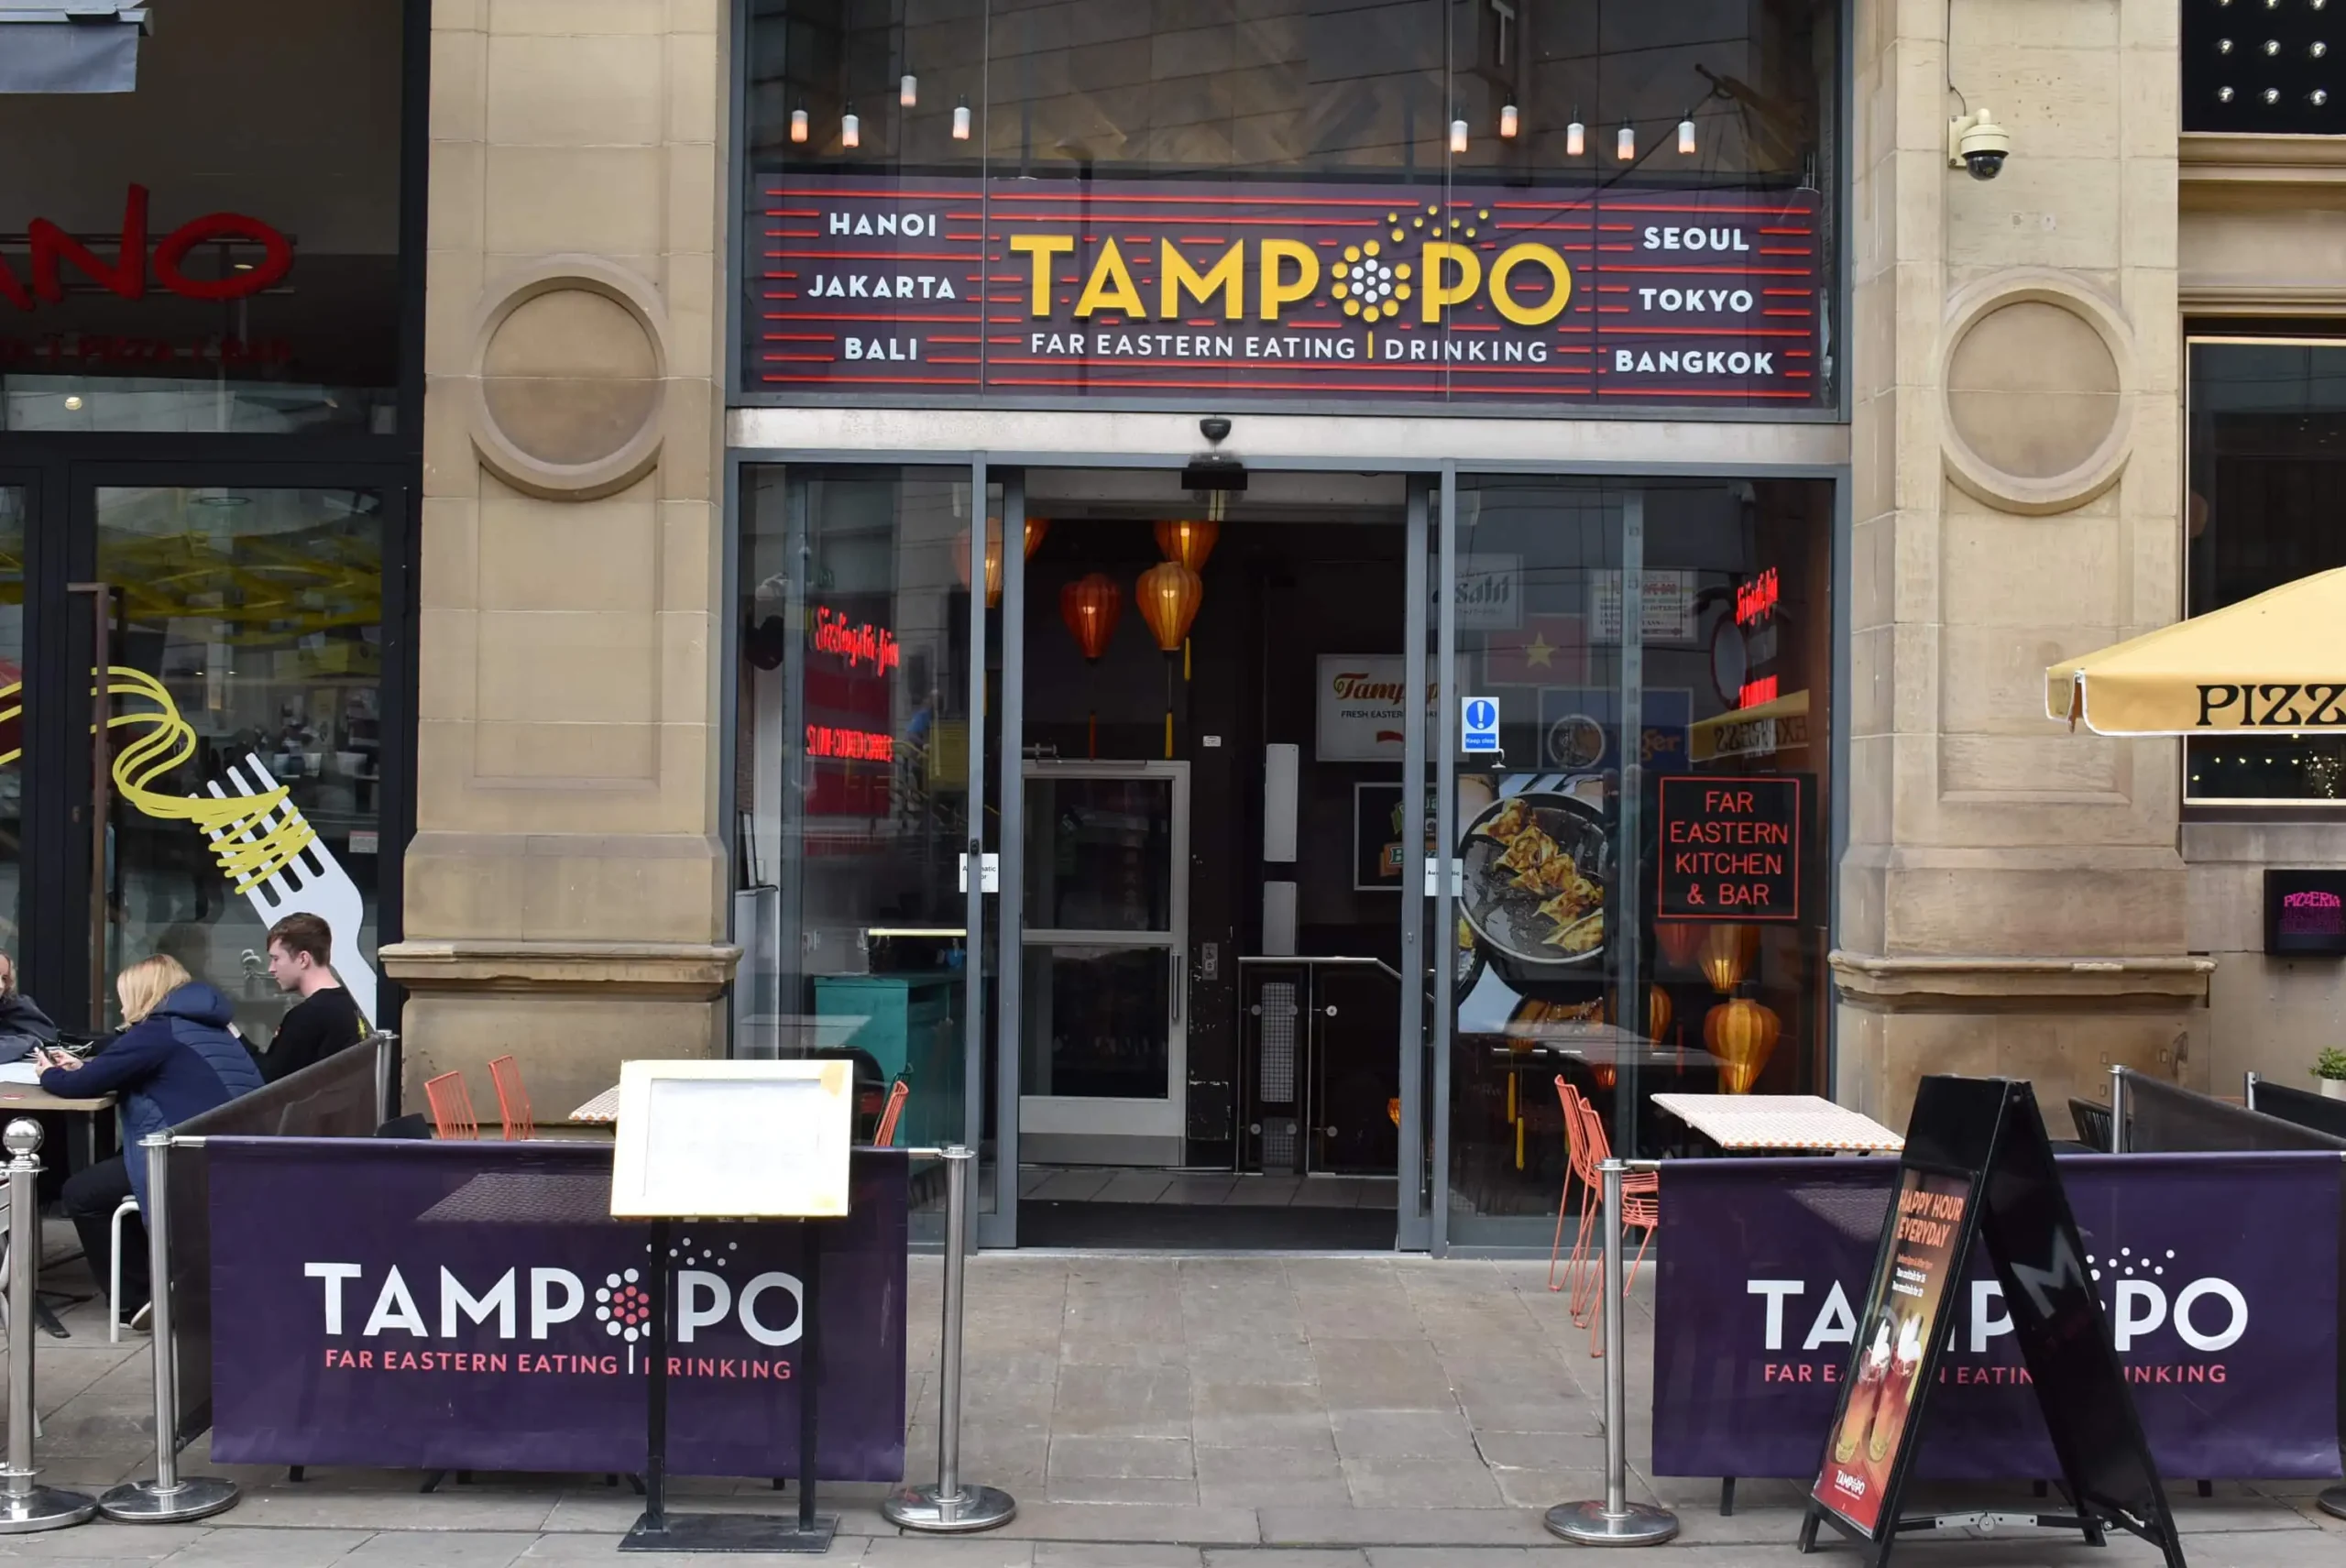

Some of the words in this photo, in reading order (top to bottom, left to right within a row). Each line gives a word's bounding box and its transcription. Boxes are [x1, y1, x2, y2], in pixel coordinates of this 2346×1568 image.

[829, 213, 937, 236] HANOI
[1643, 226, 1749, 251] SEOUL
[807, 275, 956, 300] JAKARTA
[1010, 235, 1572, 326] TAMPOPO
[1639, 288, 1753, 313] TOKYO
[845, 337, 917, 360] BALI
[1031, 333, 1085, 355] FAR
[1097, 334, 1233, 357] EASTERN
[1245, 336, 1355, 359] EATING
[1385, 339, 1548, 363] DRINKING
[1616, 350, 1774, 374] BANGKOK
[1342, 710, 1368, 719] FRESH
[1370, 710, 1405, 719] EASTER
[2196, 684, 2346, 726] PIZZ
[1705, 790, 1754, 814] FAR
[1670, 821, 1788, 844] EASTERN
[1675, 852, 1781, 875] KITCHEN
[1687, 883, 1705, 905] &
[1718, 883, 1770, 905] BAR
[2284, 891, 2341, 907] PIZZERIA
[1898, 1190, 1934, 1216] HAPPY
[1932, 1195, 1966, 1222] HOUR
[1897, 1217, 1951, 1247] EVERYDAY
[325, 1350, 373, 1368] FAR
[384, 1351, 507, 1372] EASTERN
[519, 1354, 618, 1374] EATING
[644, 1356, 792, 1380] RINKING
[1764, 1364, 1813, 1382] FAR
[1957, 1366, 2034, 1385] EATIN
[2123, 1364, 2227, 1383] INKING
